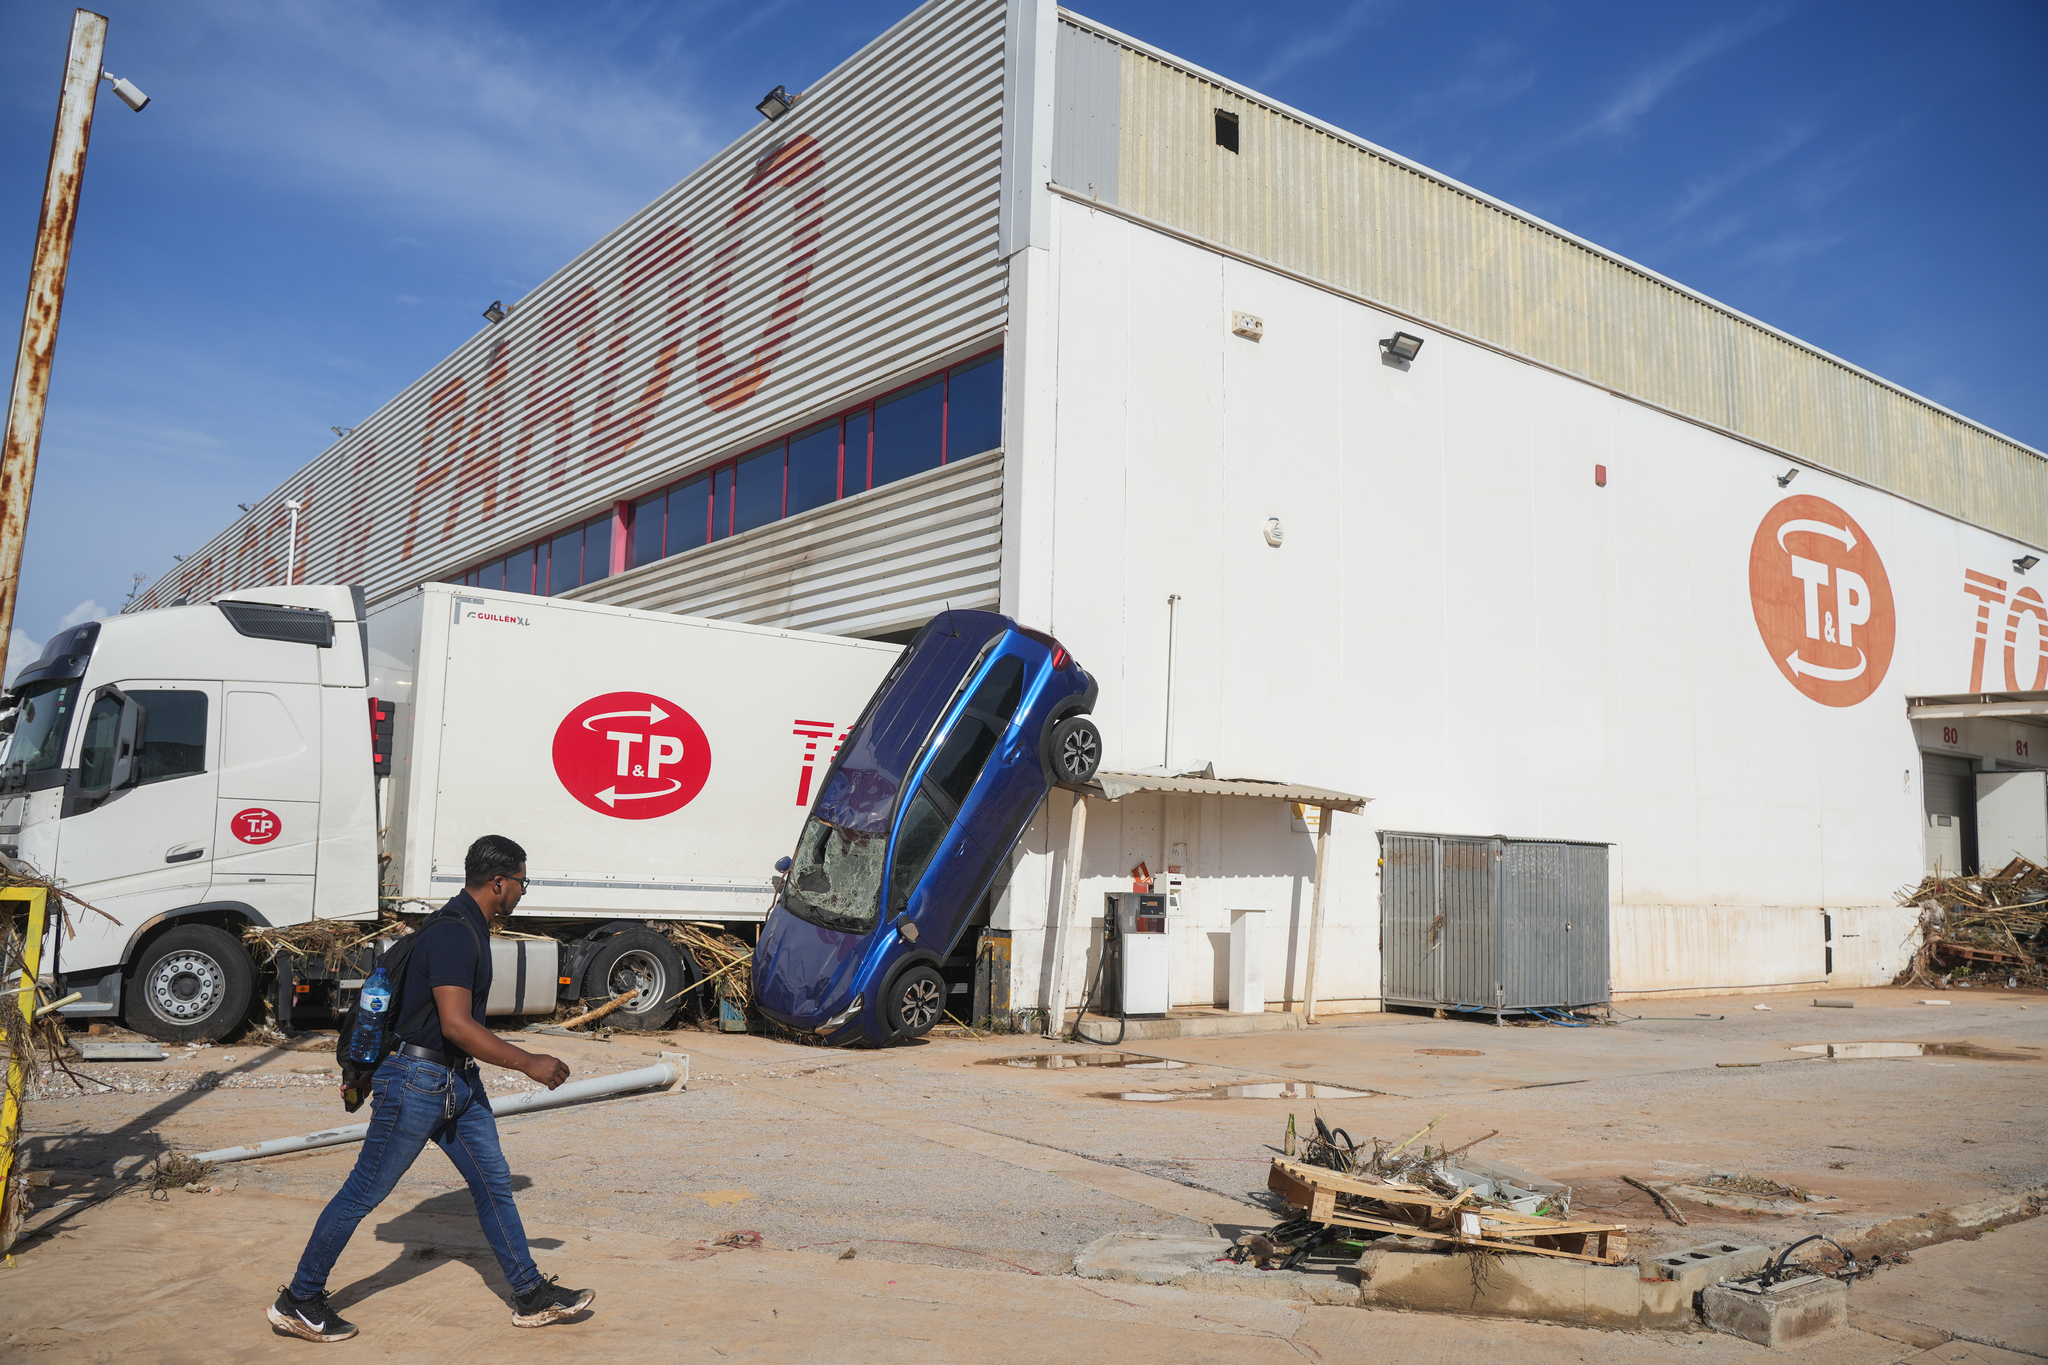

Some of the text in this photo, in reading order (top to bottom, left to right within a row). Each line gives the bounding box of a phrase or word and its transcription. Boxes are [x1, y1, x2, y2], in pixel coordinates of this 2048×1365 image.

[402, 134, 826, 561] PARDO
[1790, 554, 1871, 647] T&P
[1943, 726, 1958, 745] 80
[2016, 740, 2029, 757] 81
[606, 730, 685, 780] T&P
[247, 819, 274, 833] T&P
